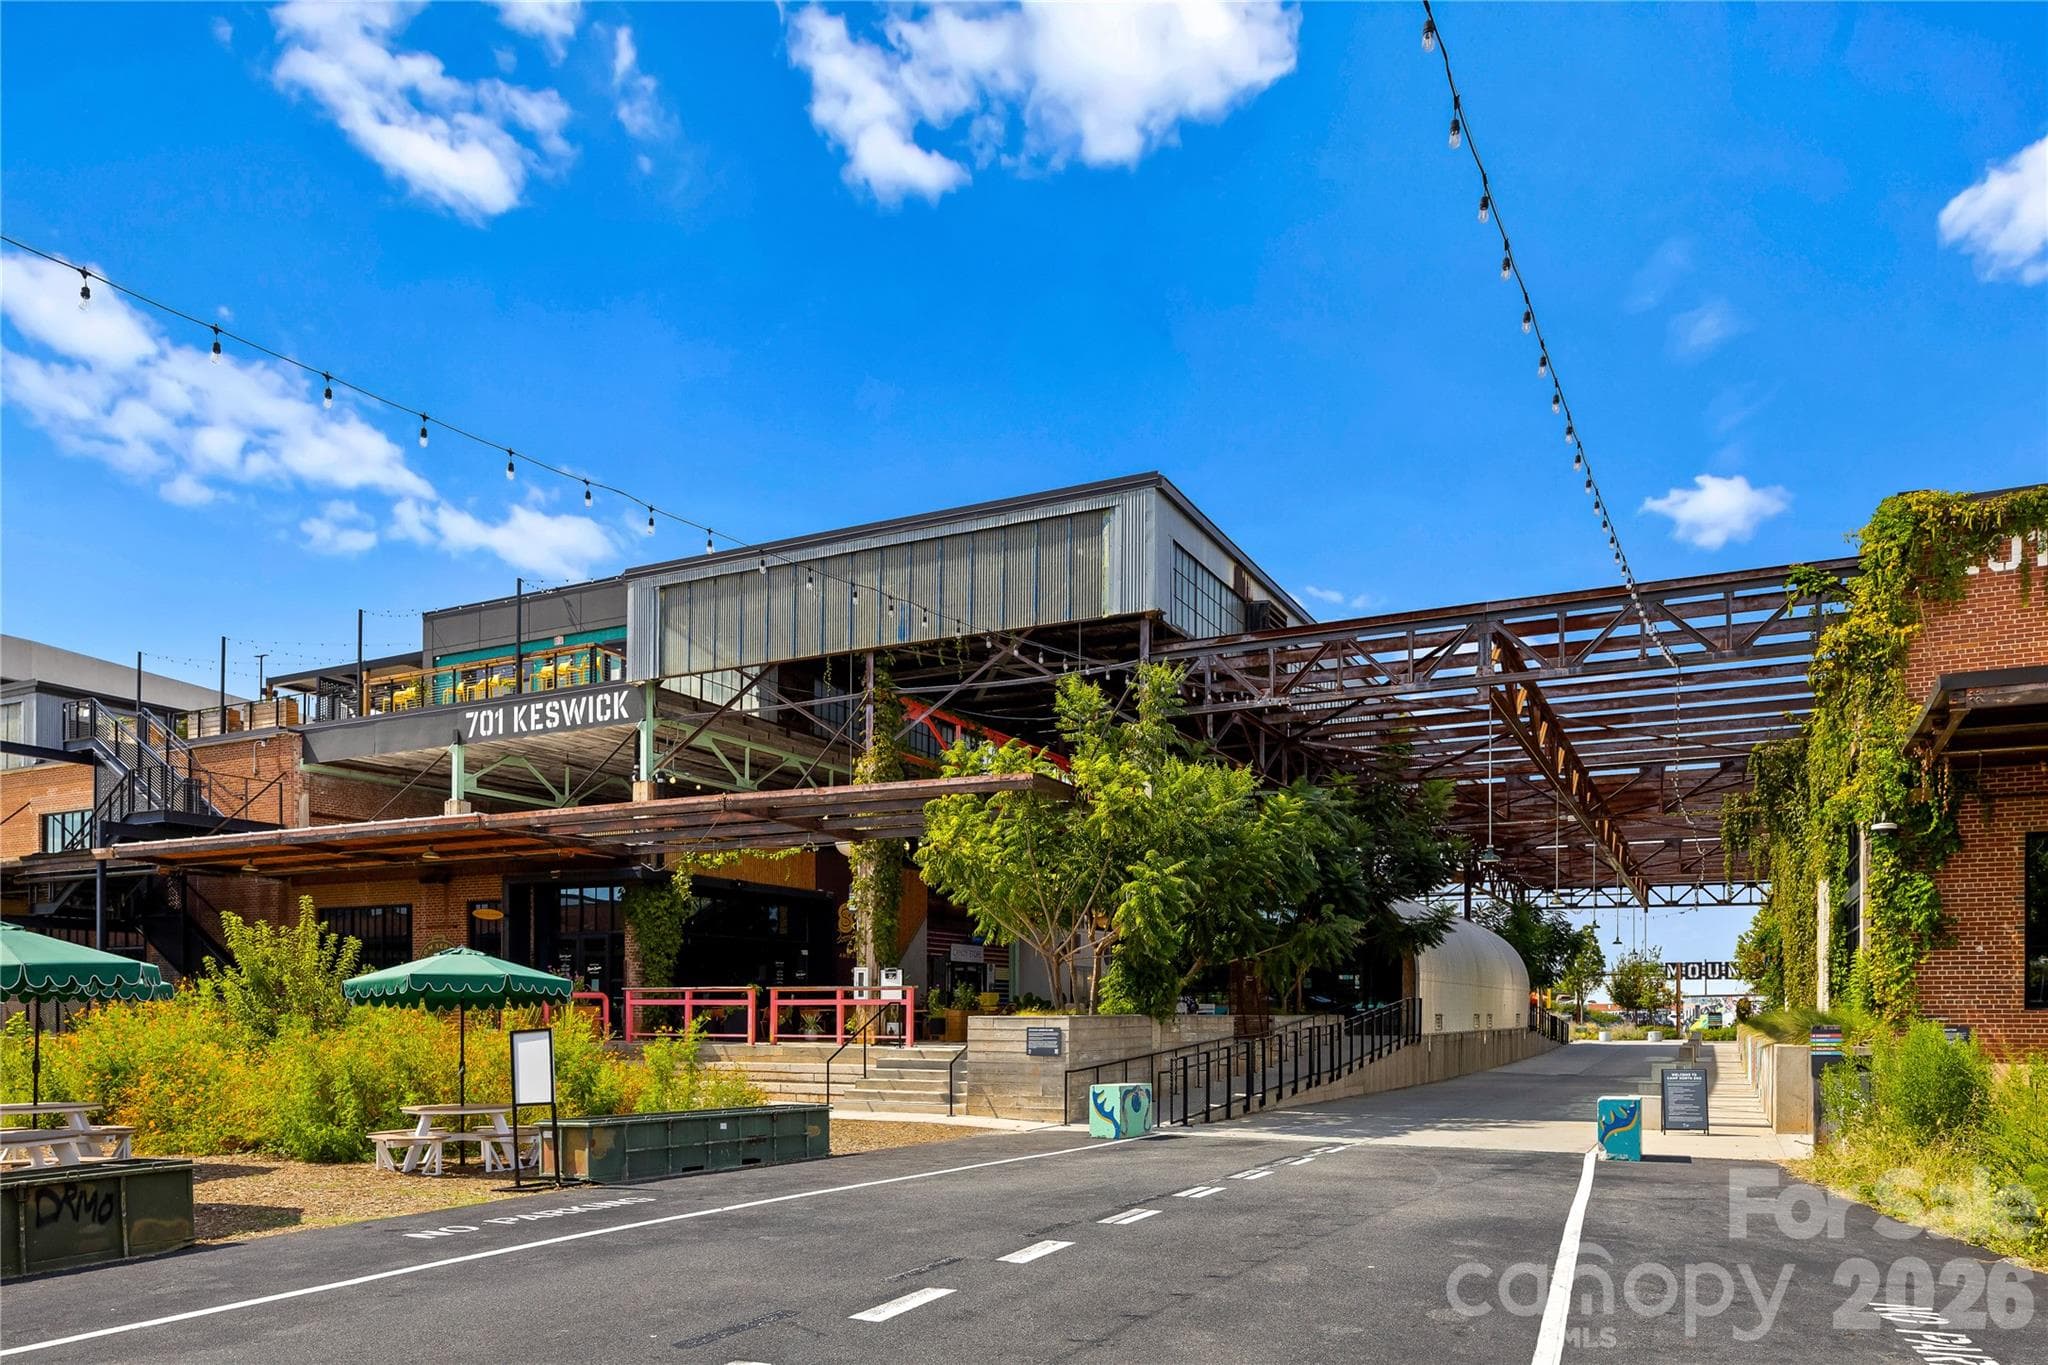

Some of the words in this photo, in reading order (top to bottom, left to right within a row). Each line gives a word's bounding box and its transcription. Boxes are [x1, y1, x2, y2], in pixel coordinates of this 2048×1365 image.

[465, 708, 504, 739] 701
[513, 690, 629, 733] KESWICK
[402, 1225, 480, 1240] NO
[485, 1197, 656, 1225] PARKING
